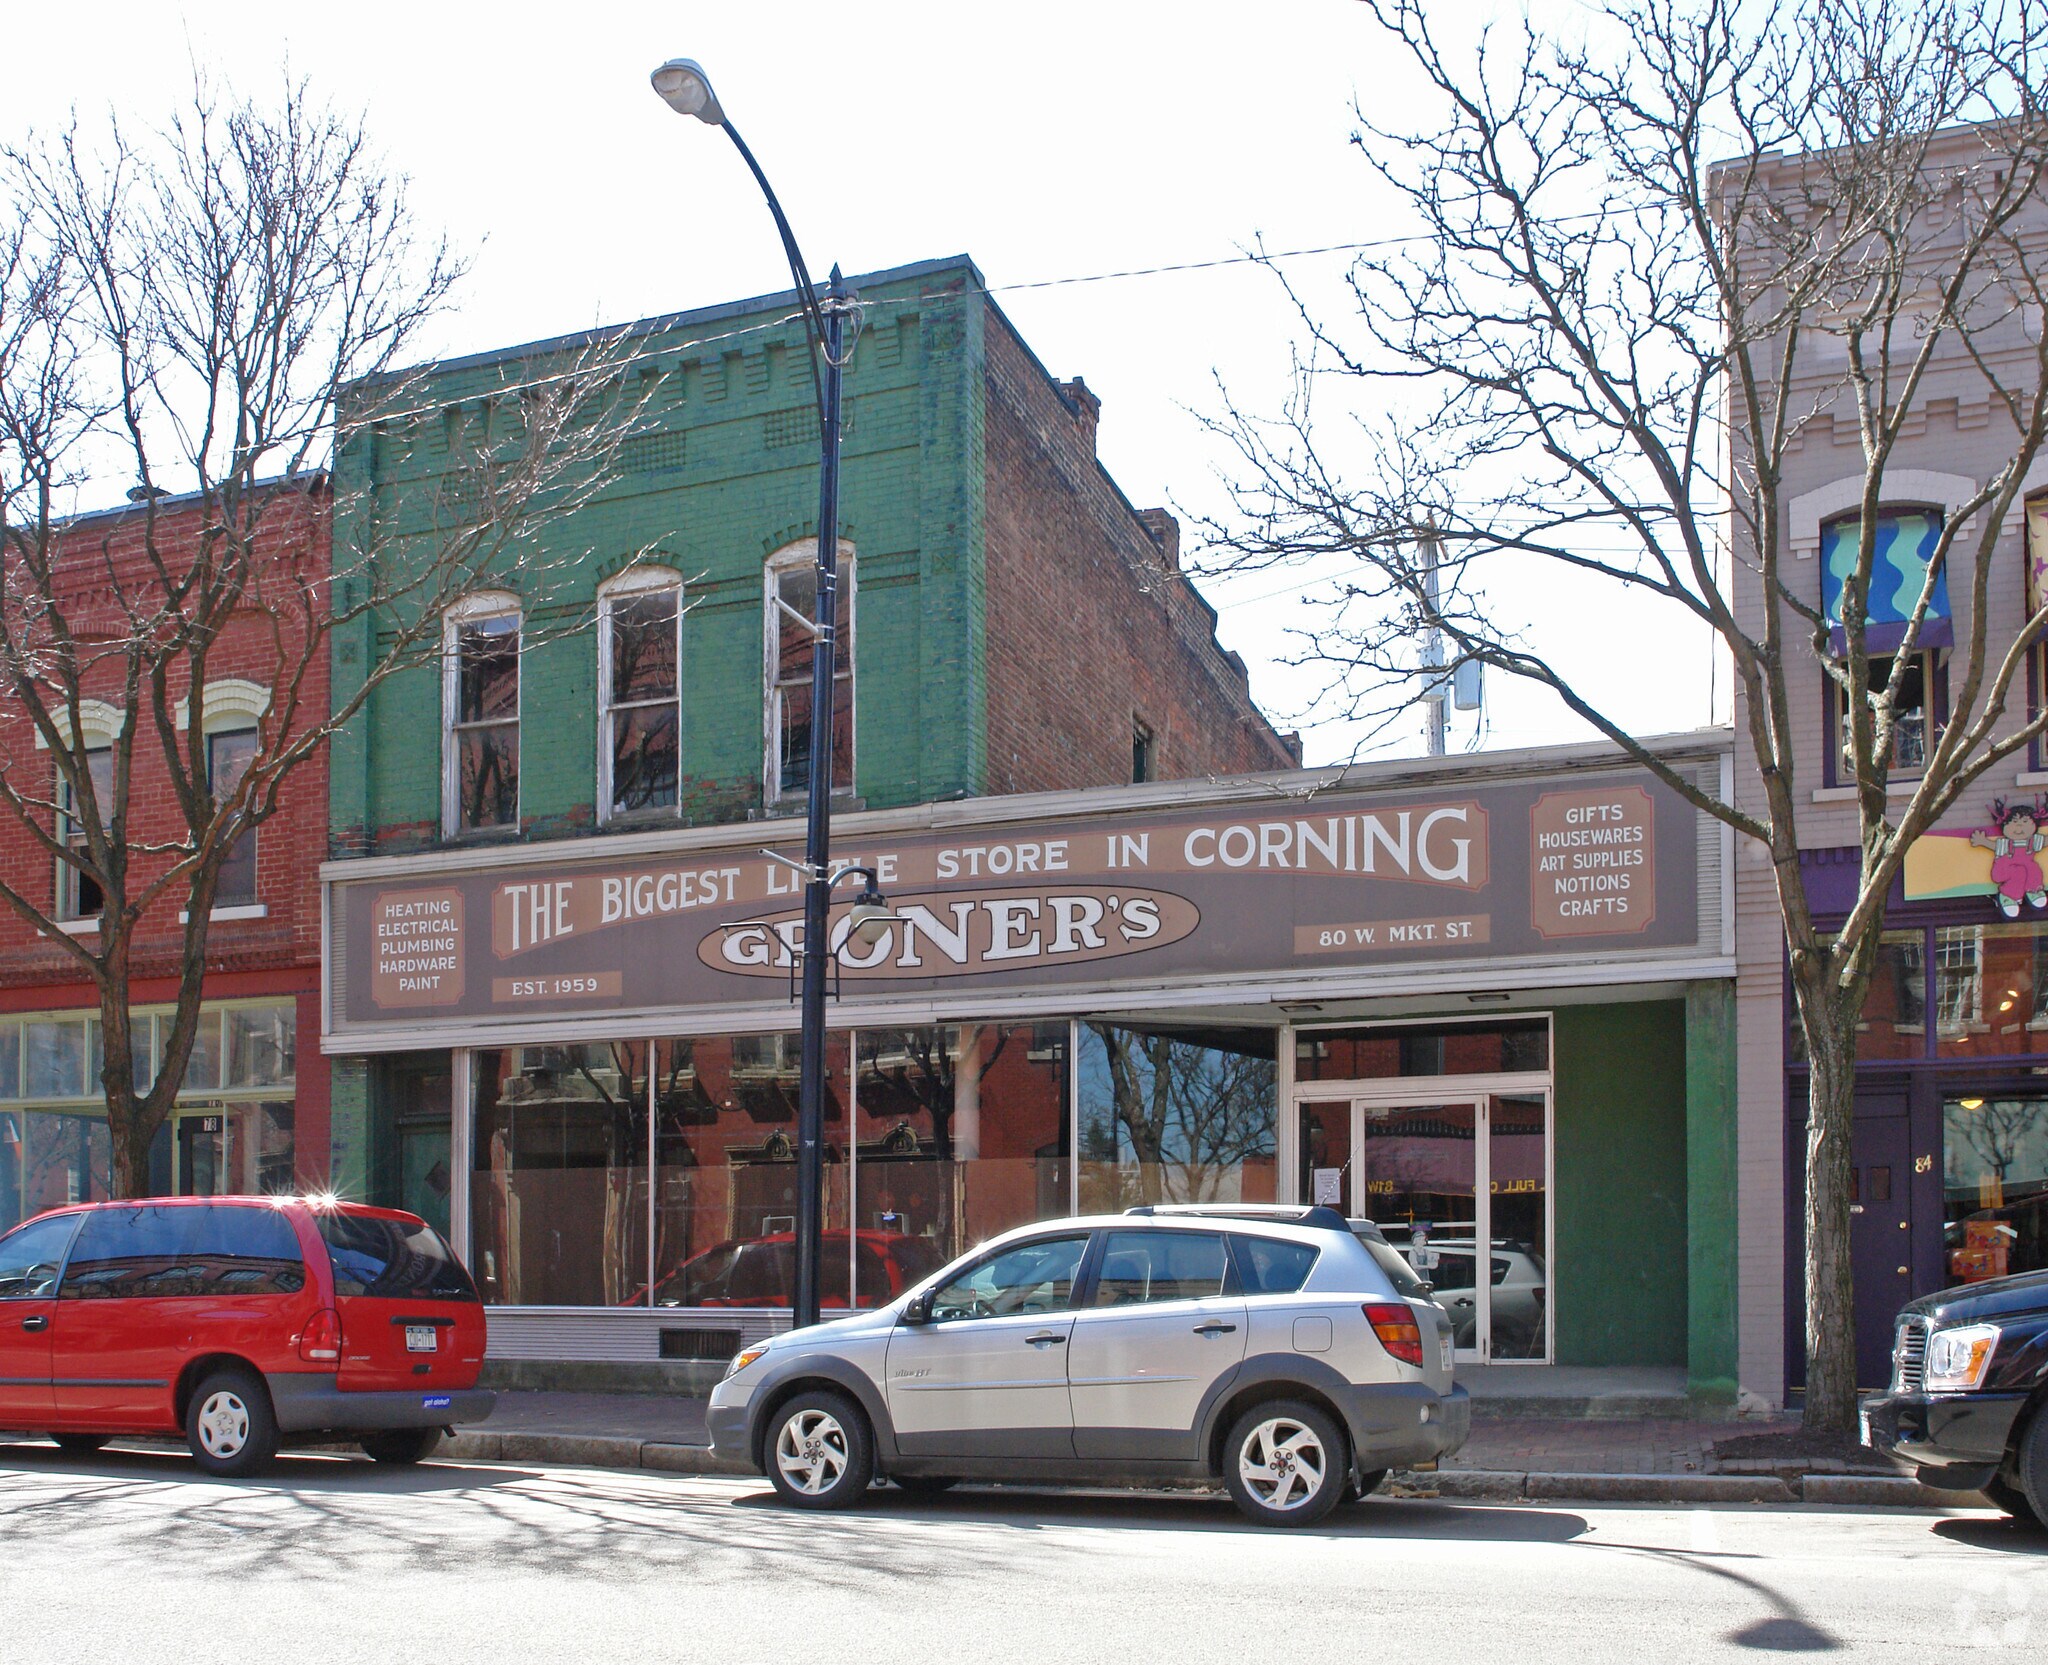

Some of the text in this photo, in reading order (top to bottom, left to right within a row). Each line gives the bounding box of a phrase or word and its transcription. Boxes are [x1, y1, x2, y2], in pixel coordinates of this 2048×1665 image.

[1566, 804, 1623, 824] GIFTS
[1539, 826, 1643, 849] HOUSEWARES
[1539, 849, 1644, 872] ART SUPPLIES
[504, 807, 1472, 951] THE BIGGEST LITLE STORE IN CORNING
[1555, 873, 1631, 894] NOTIONS
[385, 901, 451, 918] HEATING
[1560, 897, 1628, 917] CRAFTS
[378, 918, 459, 937] ELECTRICAL
[1319, 921, 1474, 946] 80 W. MKT. ST.
[381, 938, 455, 955] PLUMBING
[380, 956, 457, 974] HARDWARE
[399, 975, 441, 991] PAINT
[512, 977, 599, 996] EST. 1959
[1915, 1154, 1932, 1173] 84
